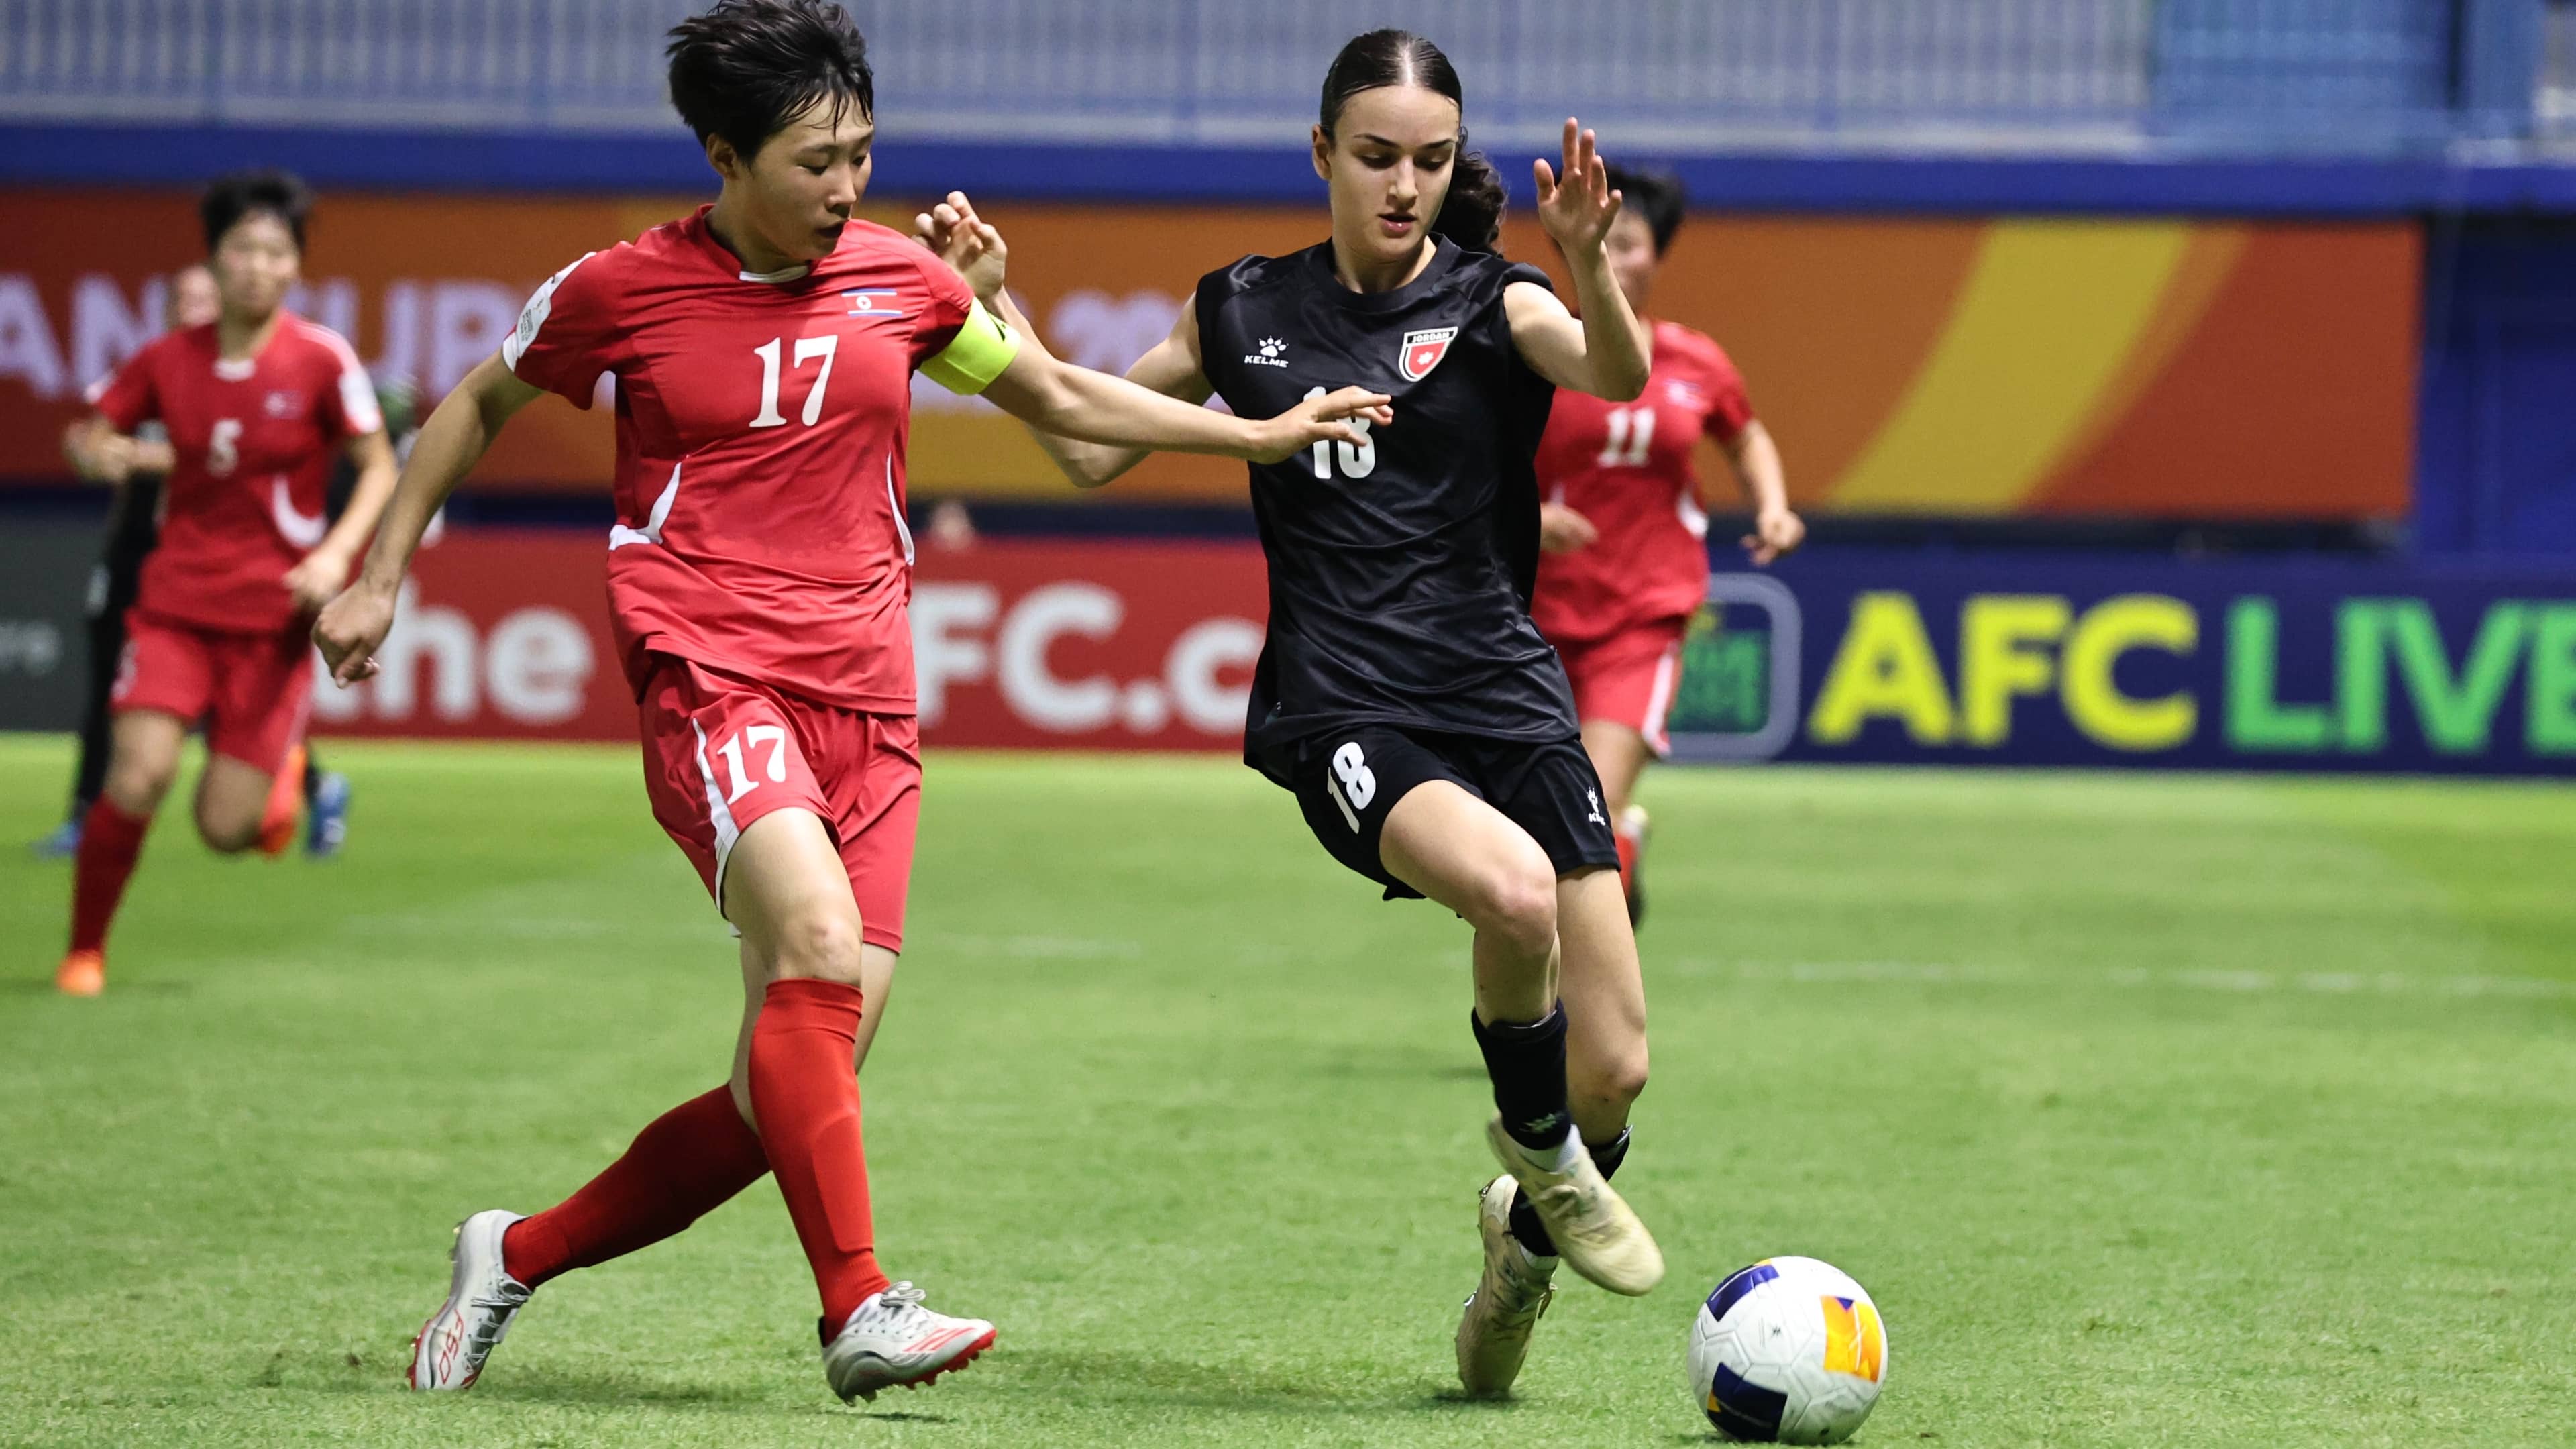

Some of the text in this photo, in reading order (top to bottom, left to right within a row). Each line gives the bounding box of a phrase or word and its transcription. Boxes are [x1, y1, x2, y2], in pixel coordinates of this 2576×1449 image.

[1244, 354, 1289, 368] KELME
[1411, 331, 1450, 343] JORDAN
[749, 334, 838, 428] 17
[207, 419, 243, 479] 5
[1597, 405, 1656, 468] 11
[1809, 592, 2199, 751] AFC
[717, 725, 786, 806] 17
[1328, 741, 1377, 835] 18
